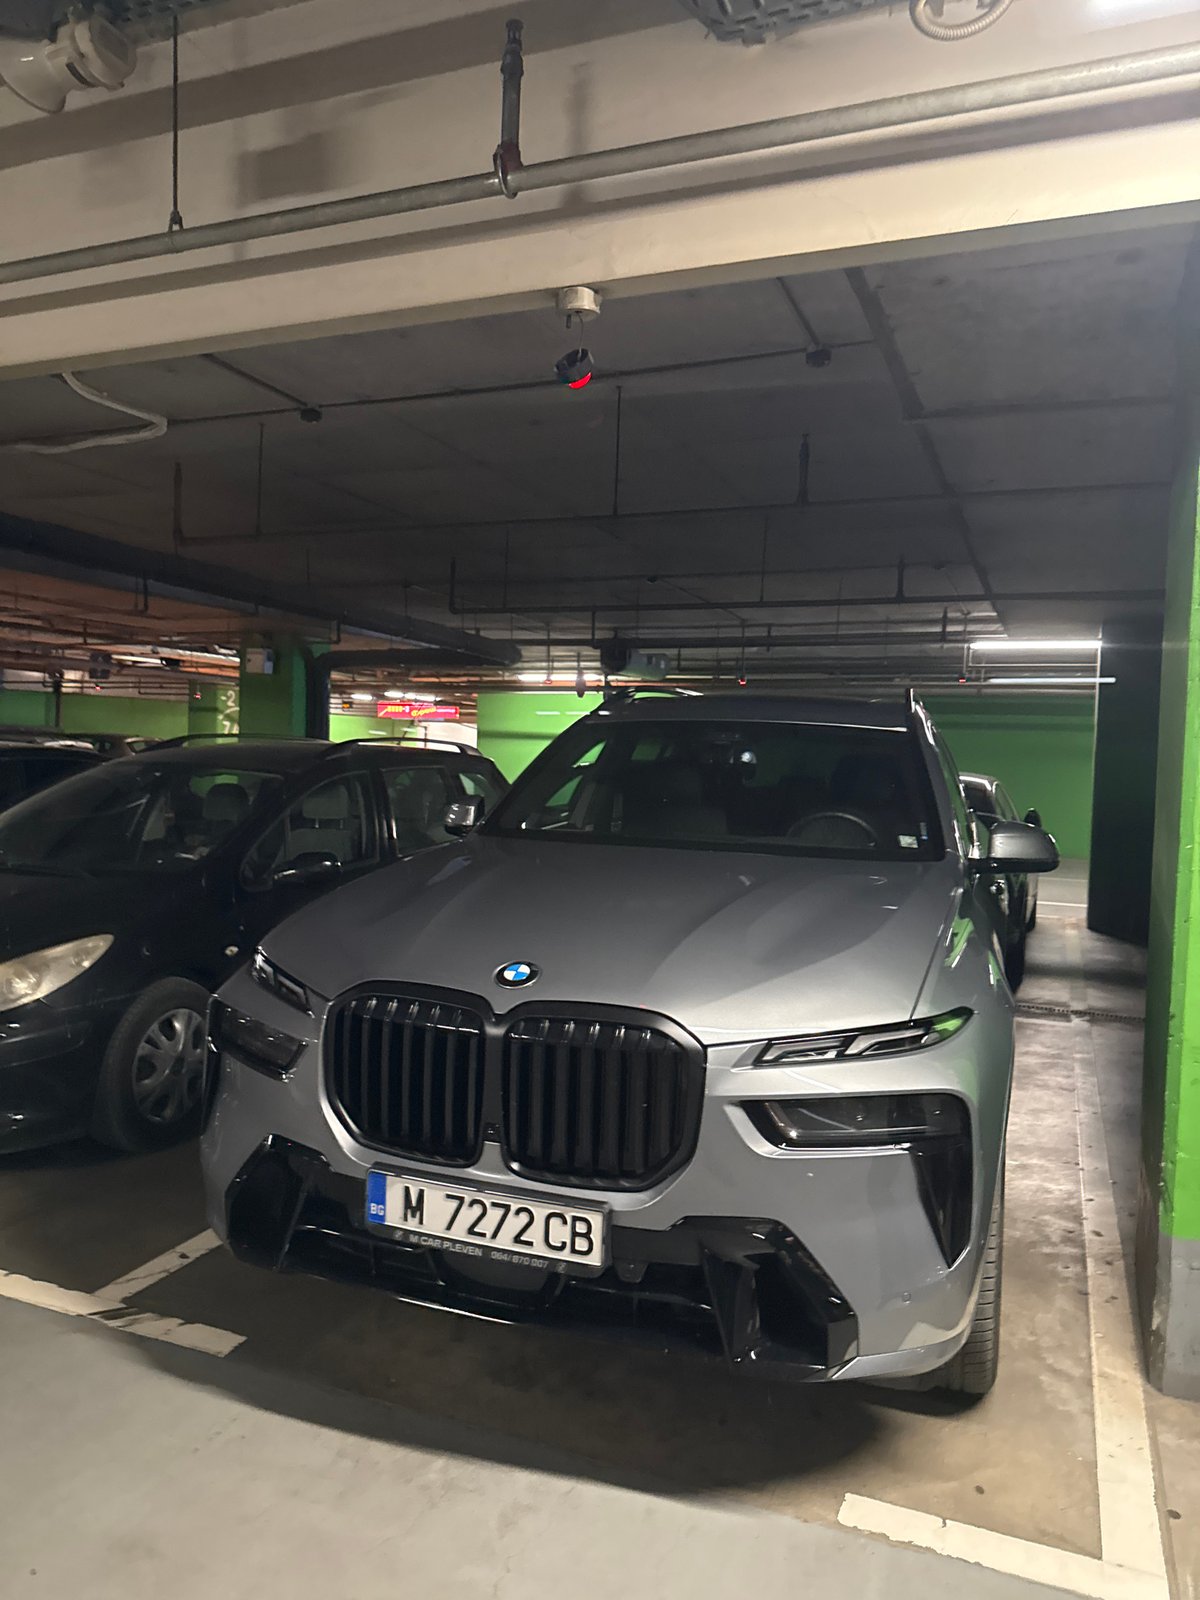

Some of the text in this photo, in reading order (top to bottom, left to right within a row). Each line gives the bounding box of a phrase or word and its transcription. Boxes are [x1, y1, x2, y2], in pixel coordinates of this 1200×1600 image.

[220, 690, 236, 707] -2
[370, 1203, 385, 1216] BG
[403, 1185, 594, 1256] M 7272 CB
[420, 1236, 442, 1249] CAR
[443, 1241, 484, 1257] PLEVEN
